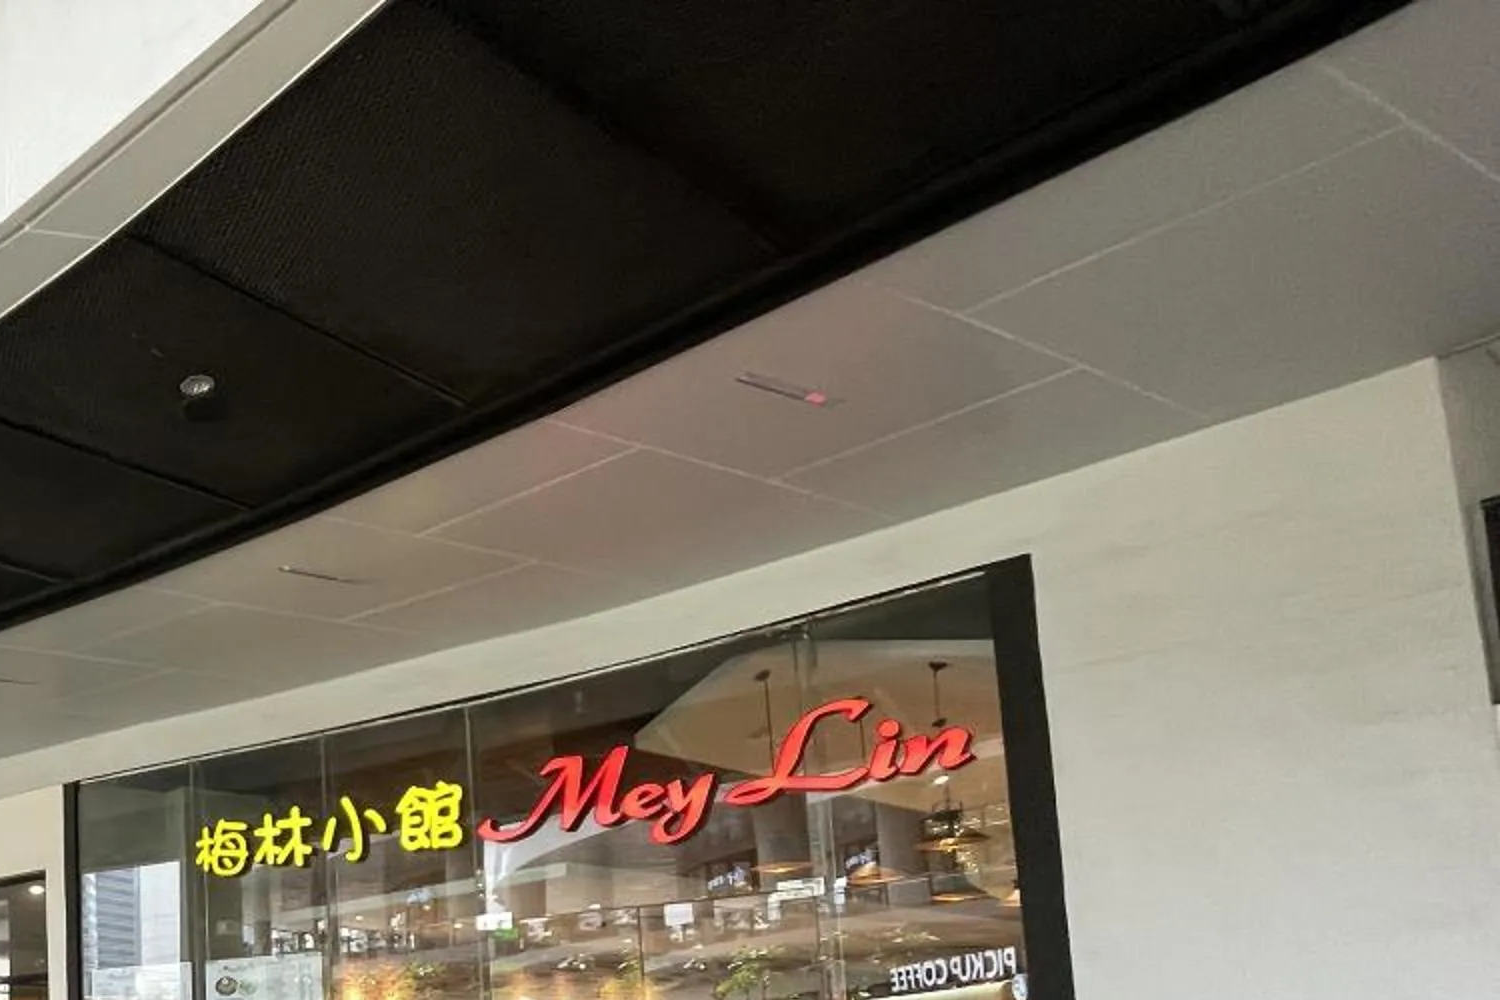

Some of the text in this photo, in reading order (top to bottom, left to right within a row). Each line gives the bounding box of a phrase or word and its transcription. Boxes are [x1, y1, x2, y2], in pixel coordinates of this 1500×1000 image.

[196, 781, 463, 877] 梅林小館
[477, 697, 976, 844] Mey Lin
